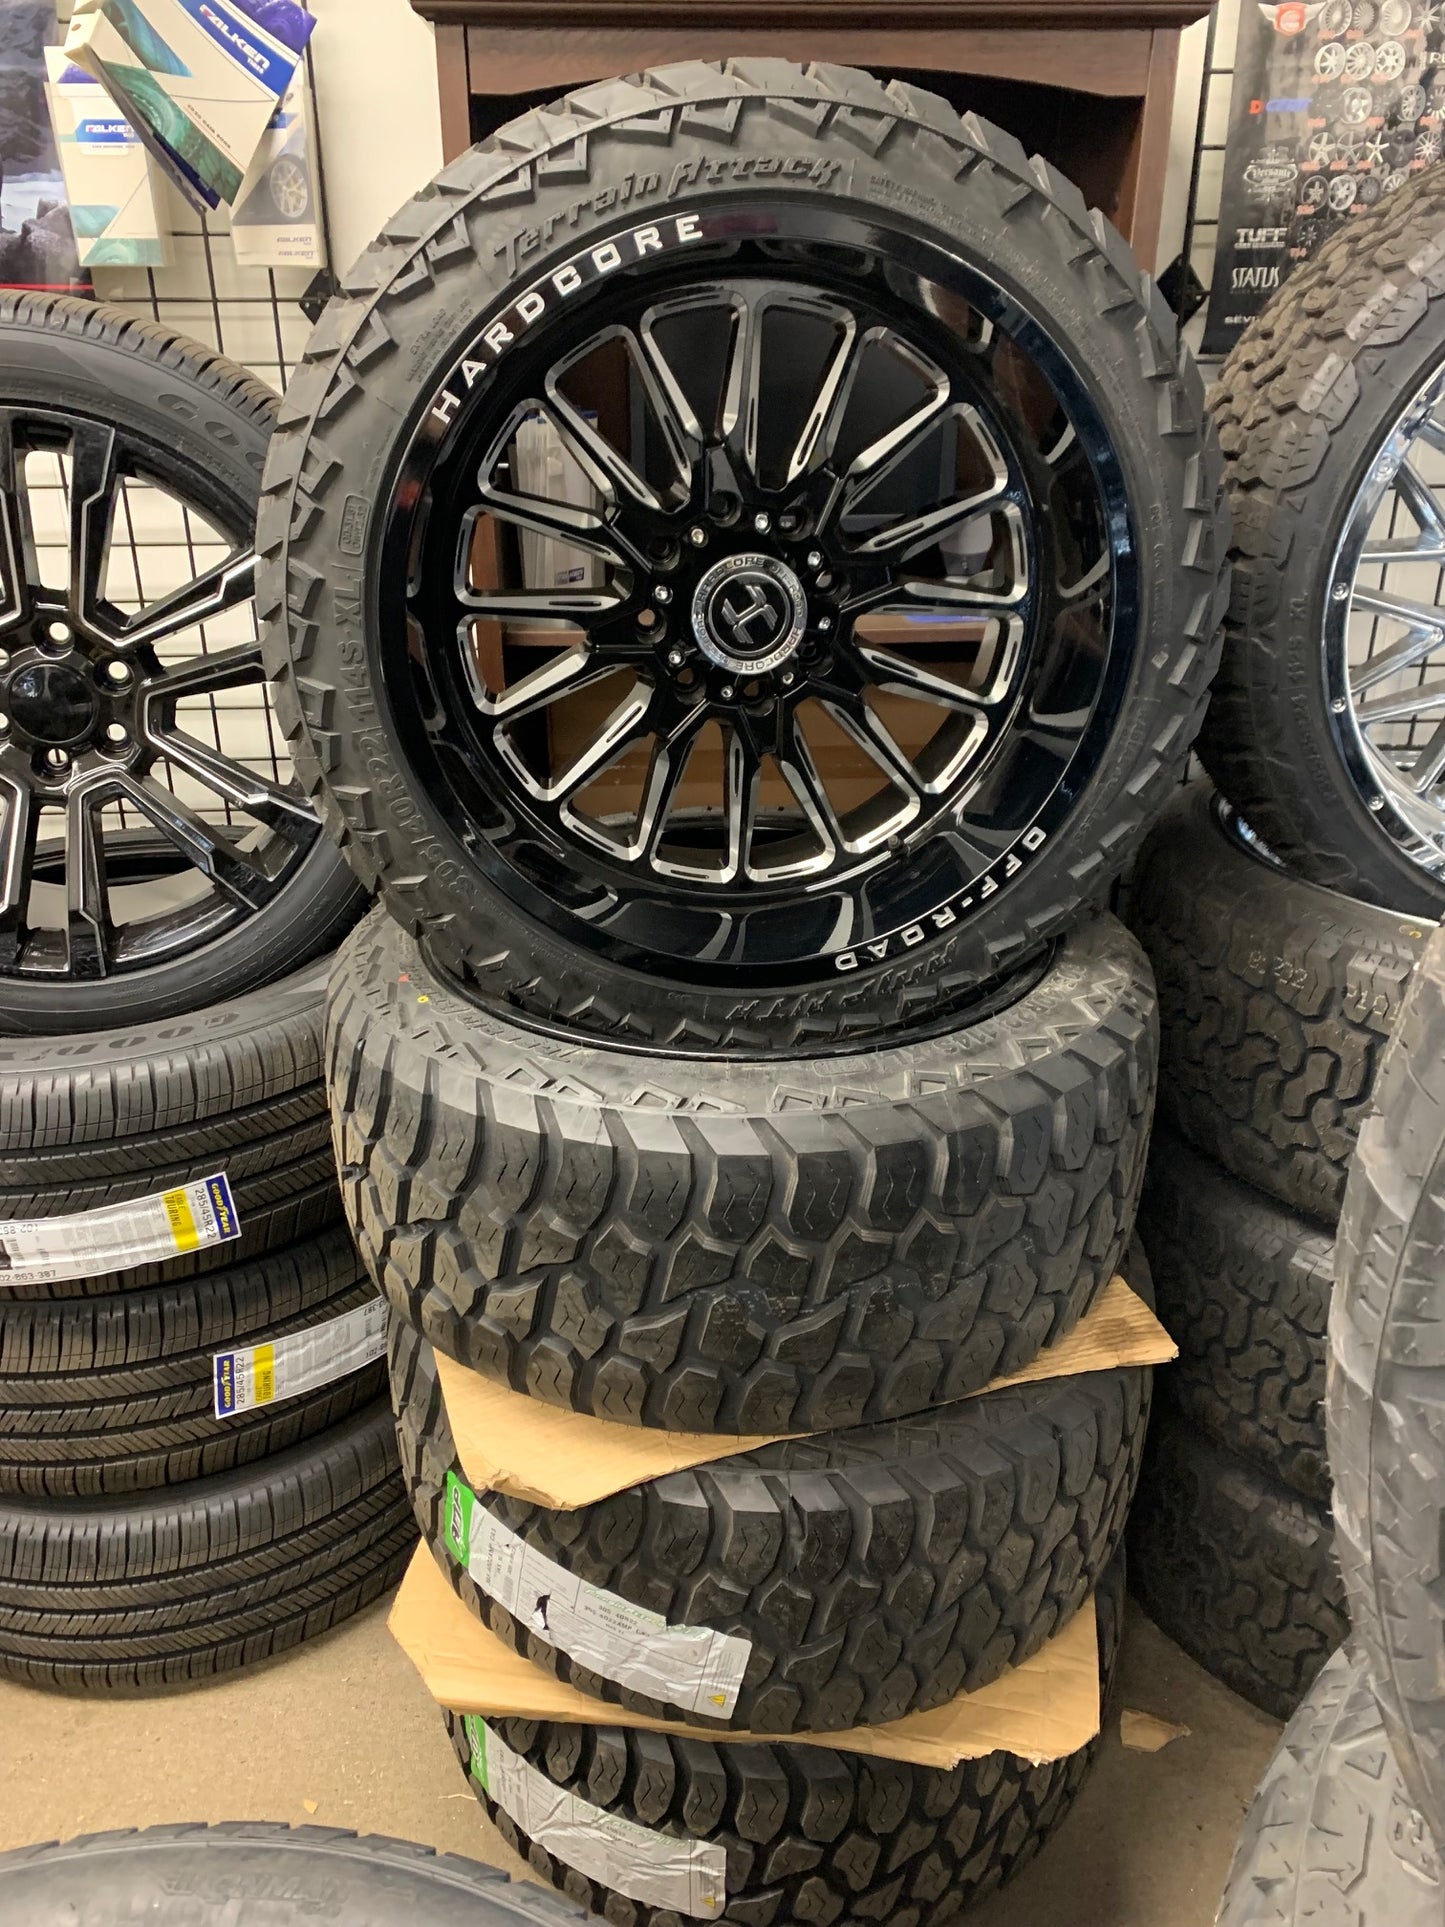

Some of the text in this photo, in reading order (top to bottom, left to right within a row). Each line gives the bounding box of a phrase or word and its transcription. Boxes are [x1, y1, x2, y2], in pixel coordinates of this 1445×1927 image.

[200, 4, 271, 70] FALKEN
[494, 156, 842, 278] Terrain Attack
[1236, 228, 1288, 243] TUFF
[1231, 266, 1280, 288] STATUS
[432, 213, 703, 425] HARDCORE
[834, 826, 1047, 971] OFF-ROAD
[165, 1195, 182, 1228] TOURING
[194, 1187, 217, 1240] 285/45R22
[210, 1182, 232, 1235] GOODYEAR
[222, 1358, 235, 1408] GOODYEAR
[236, 1355, 245, 1404] 285/45R22
[262, 1369, 272, 1401] TOURING
